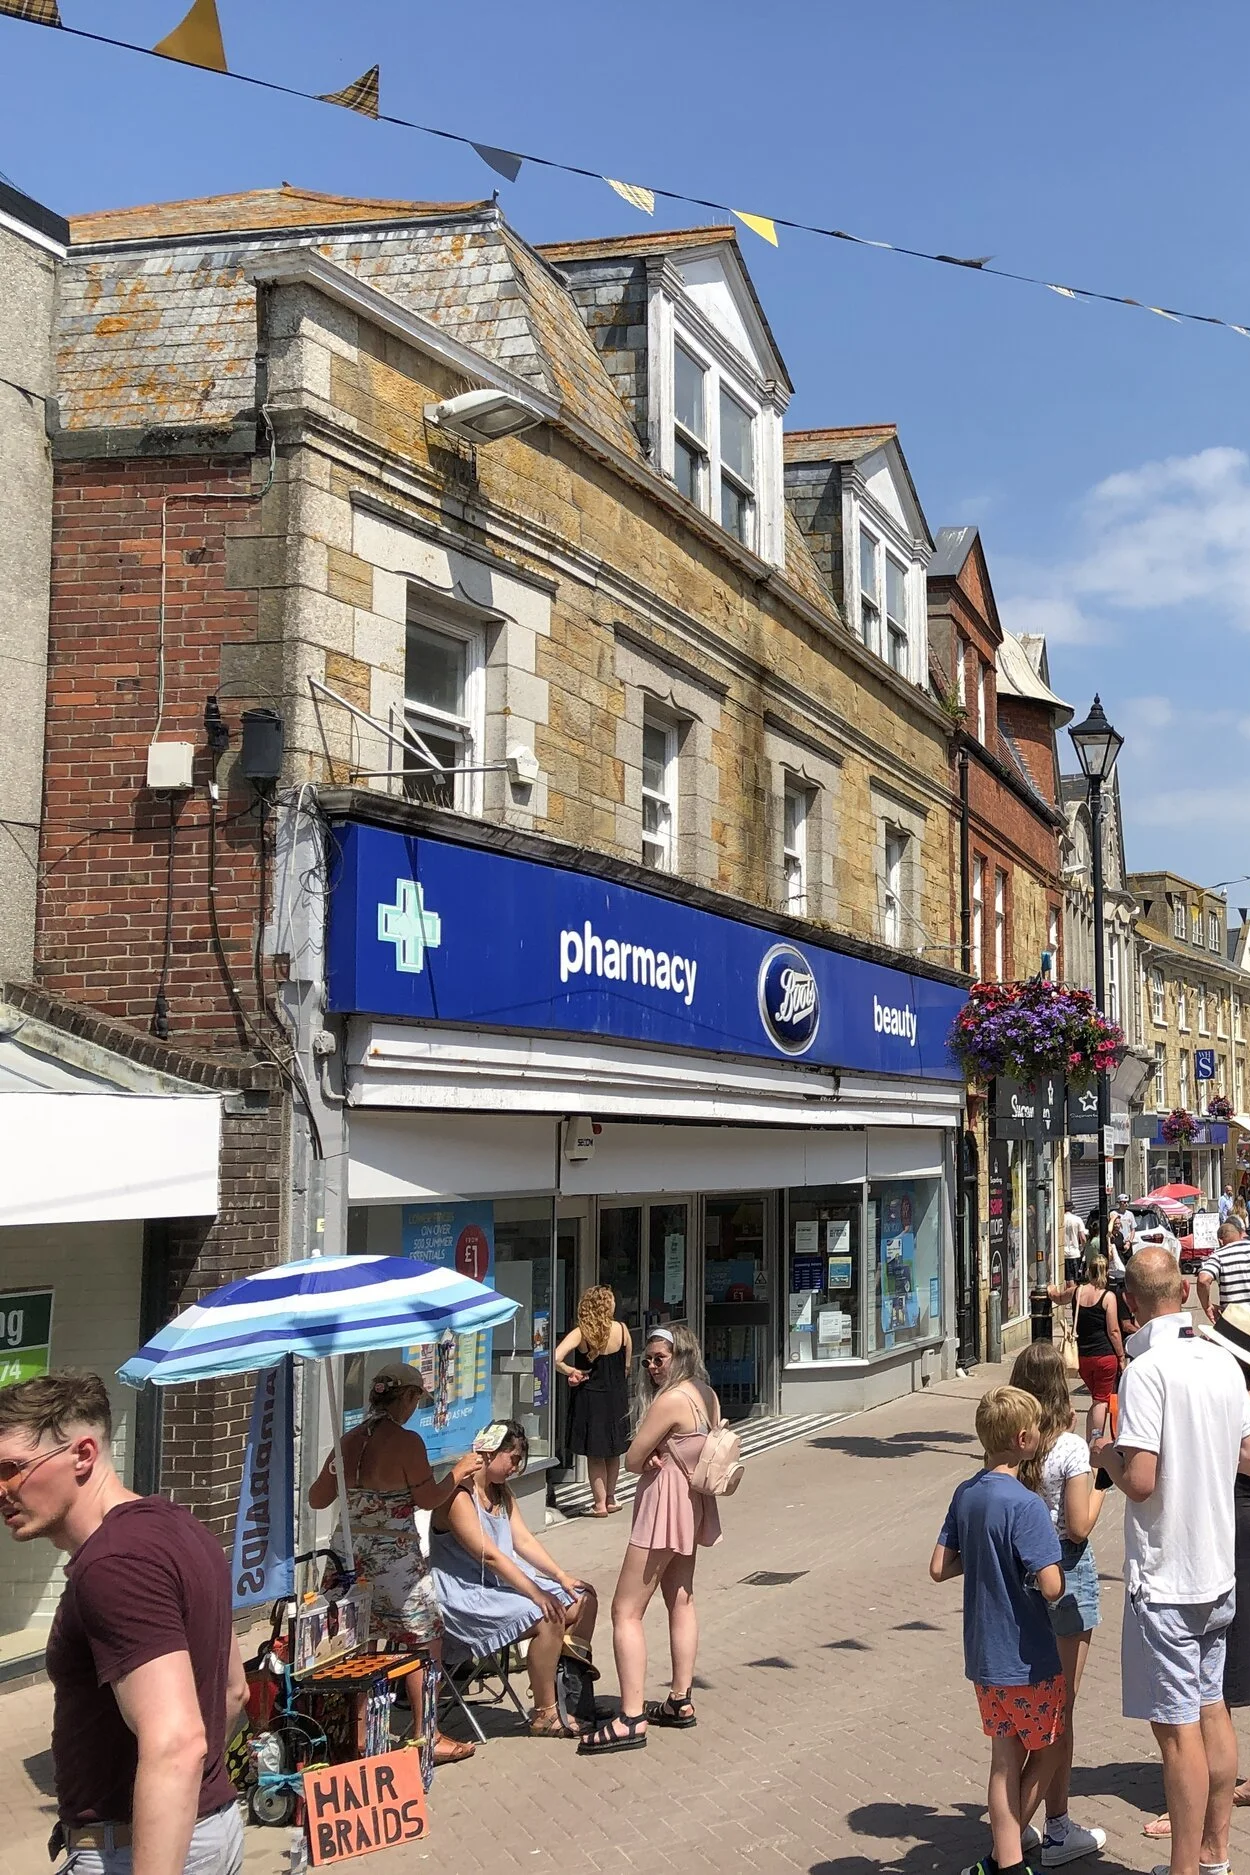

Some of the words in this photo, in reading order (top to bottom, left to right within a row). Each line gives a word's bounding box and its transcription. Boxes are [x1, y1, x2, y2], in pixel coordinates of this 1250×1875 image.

[559, 920, 698, 1006] pharmacy
[775, 968, 816, 1025] Boots
[873, 995, 918, 1047] beauty
[425, 1236, 453, 1249] SUMMER
[464, 1245, 478, 1278] £1
[0, 1359, 22, 1381] 74
